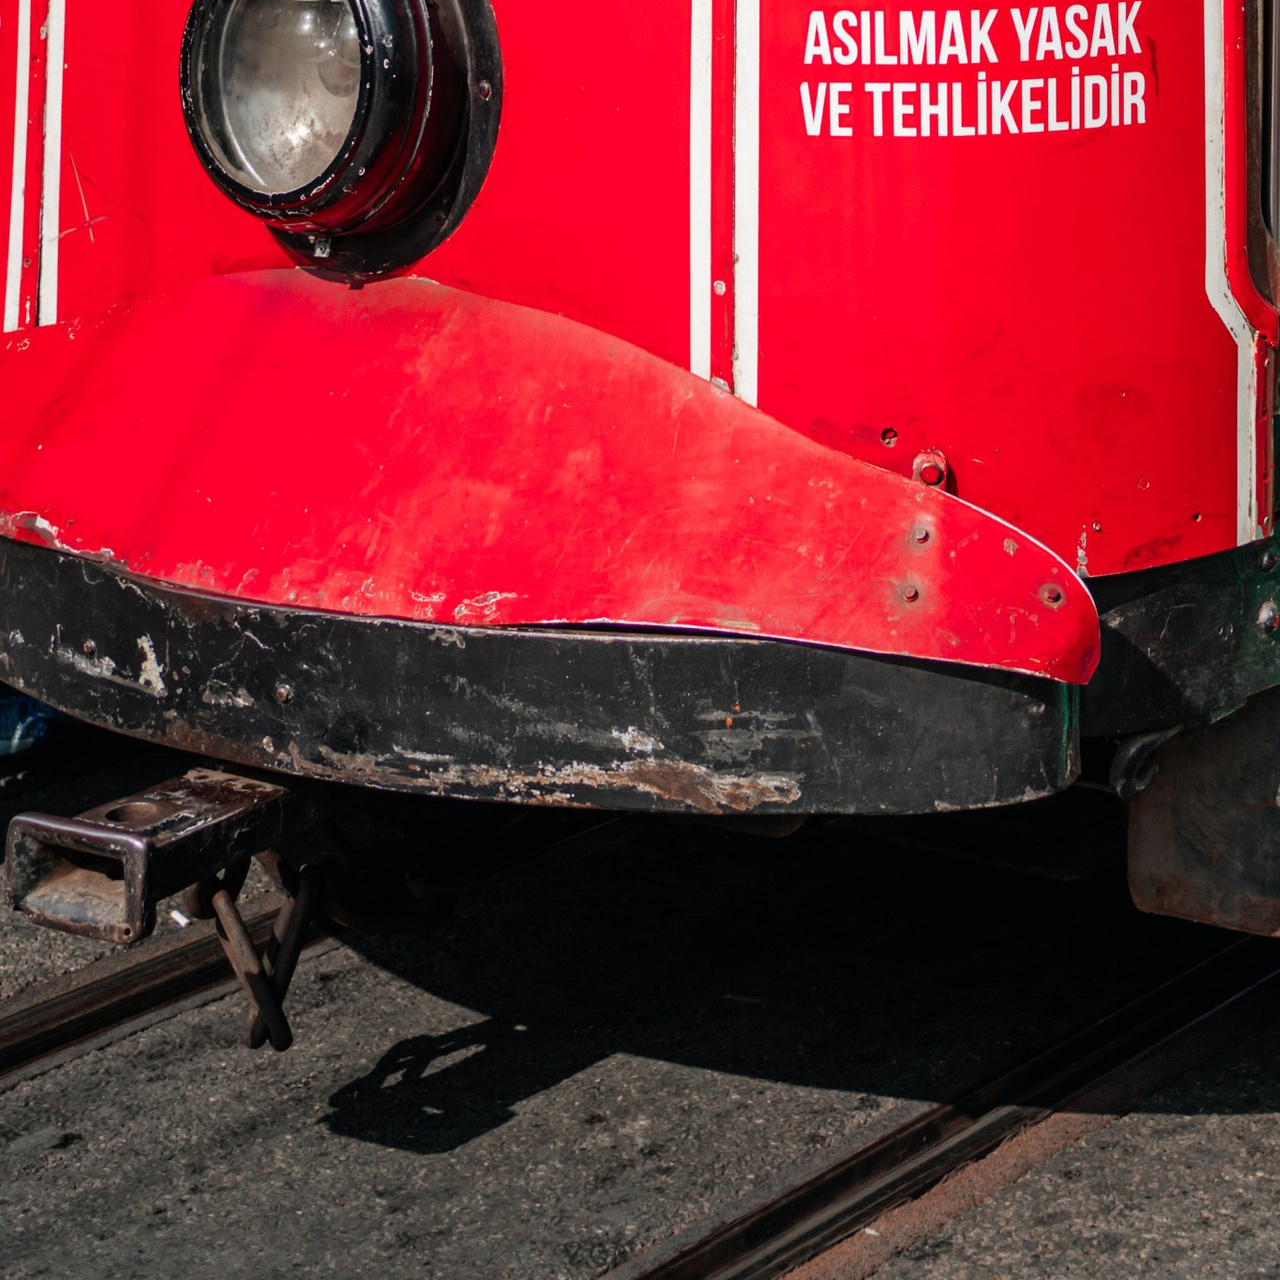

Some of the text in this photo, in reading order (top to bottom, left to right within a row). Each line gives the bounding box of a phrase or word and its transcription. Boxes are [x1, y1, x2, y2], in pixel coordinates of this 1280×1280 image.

[803, 0, 1142, 66] ASILMAK YASAK
[799, 63, 1147, 137] VE TEHLİKELİDİR
